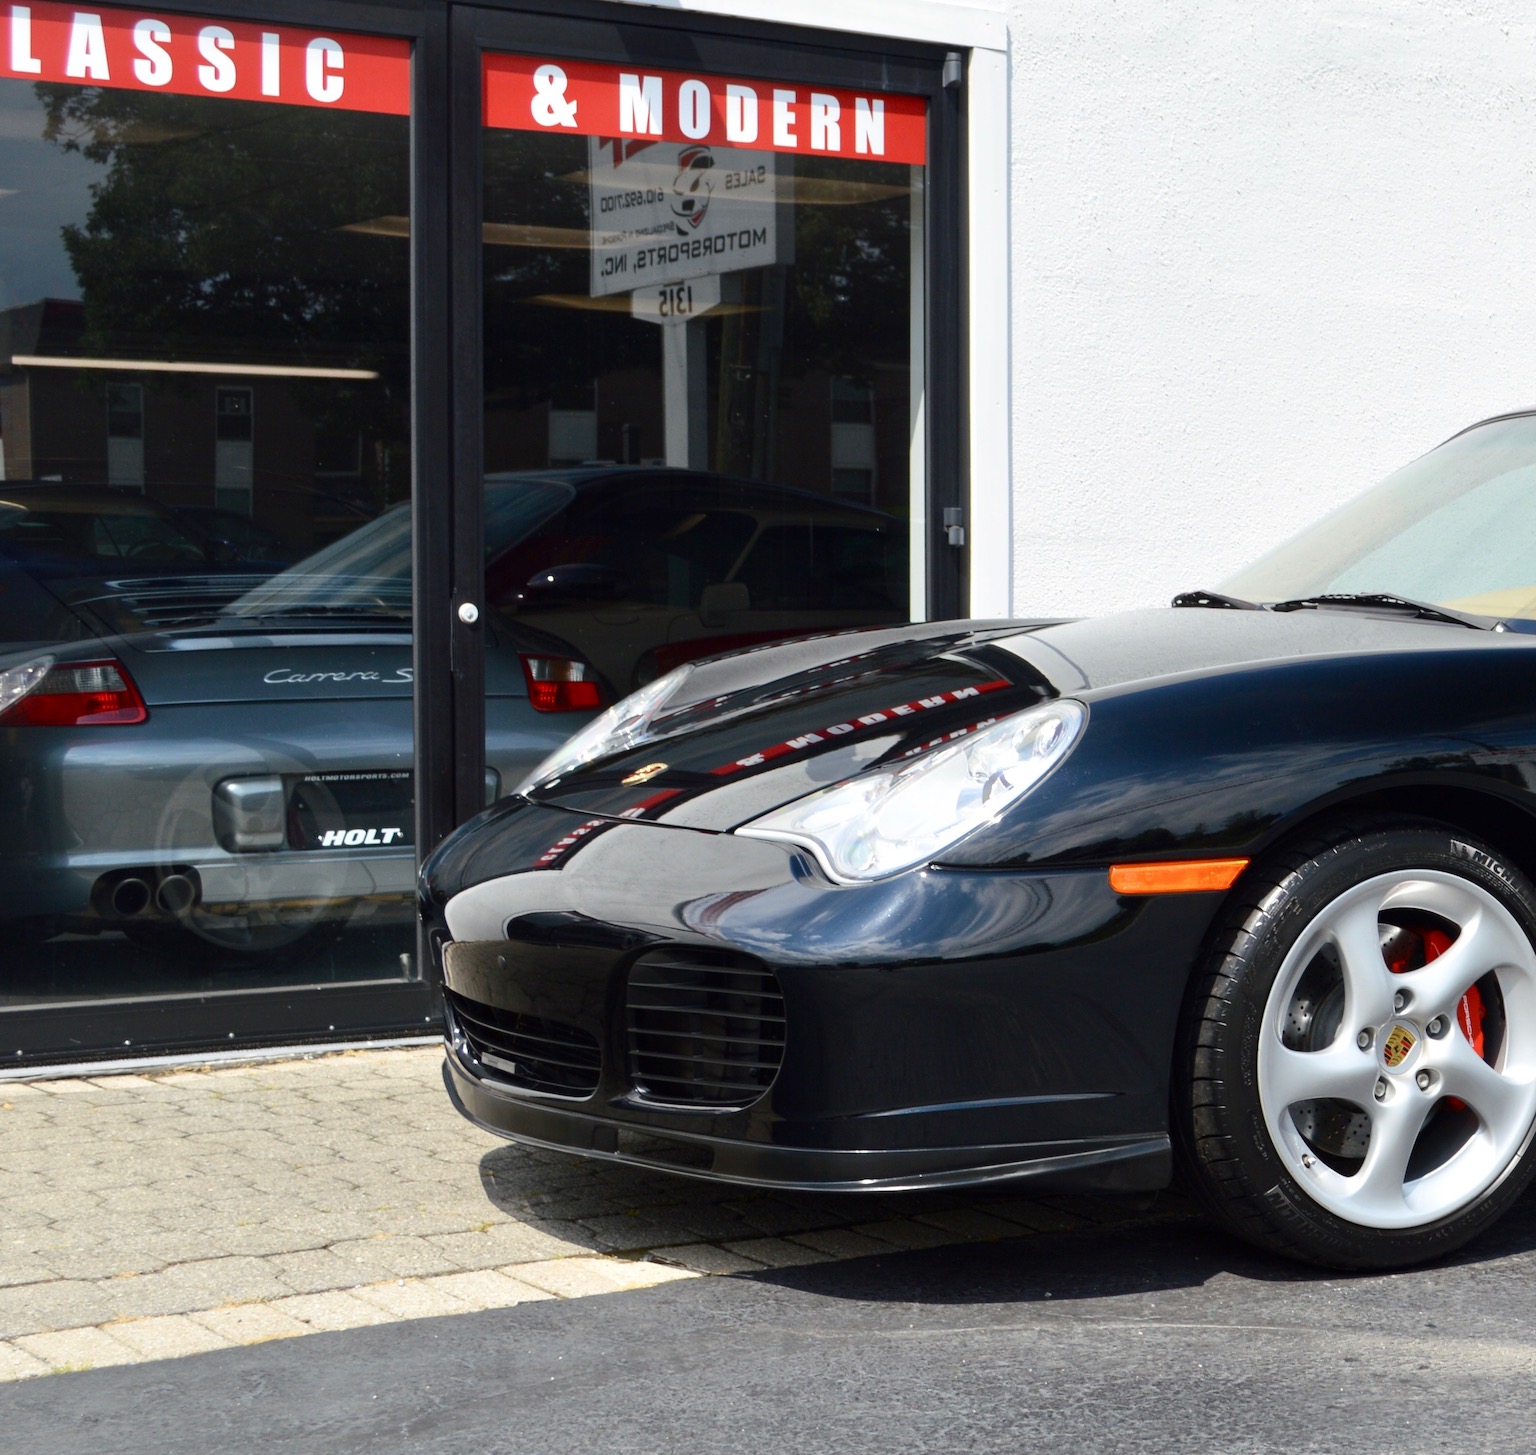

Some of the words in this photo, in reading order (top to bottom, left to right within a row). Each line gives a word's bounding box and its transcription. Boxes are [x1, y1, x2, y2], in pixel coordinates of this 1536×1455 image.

[530, 64, 578, 128] &
[619, 73, 885, 156] MODERN
[263, 669, 381, 684] Carrera
[382, 668, 414, 683] S
[304, 772, 410, 782] HOLTMOTORSPORTS.COM
[321, 827, 401, 847] HOLT
